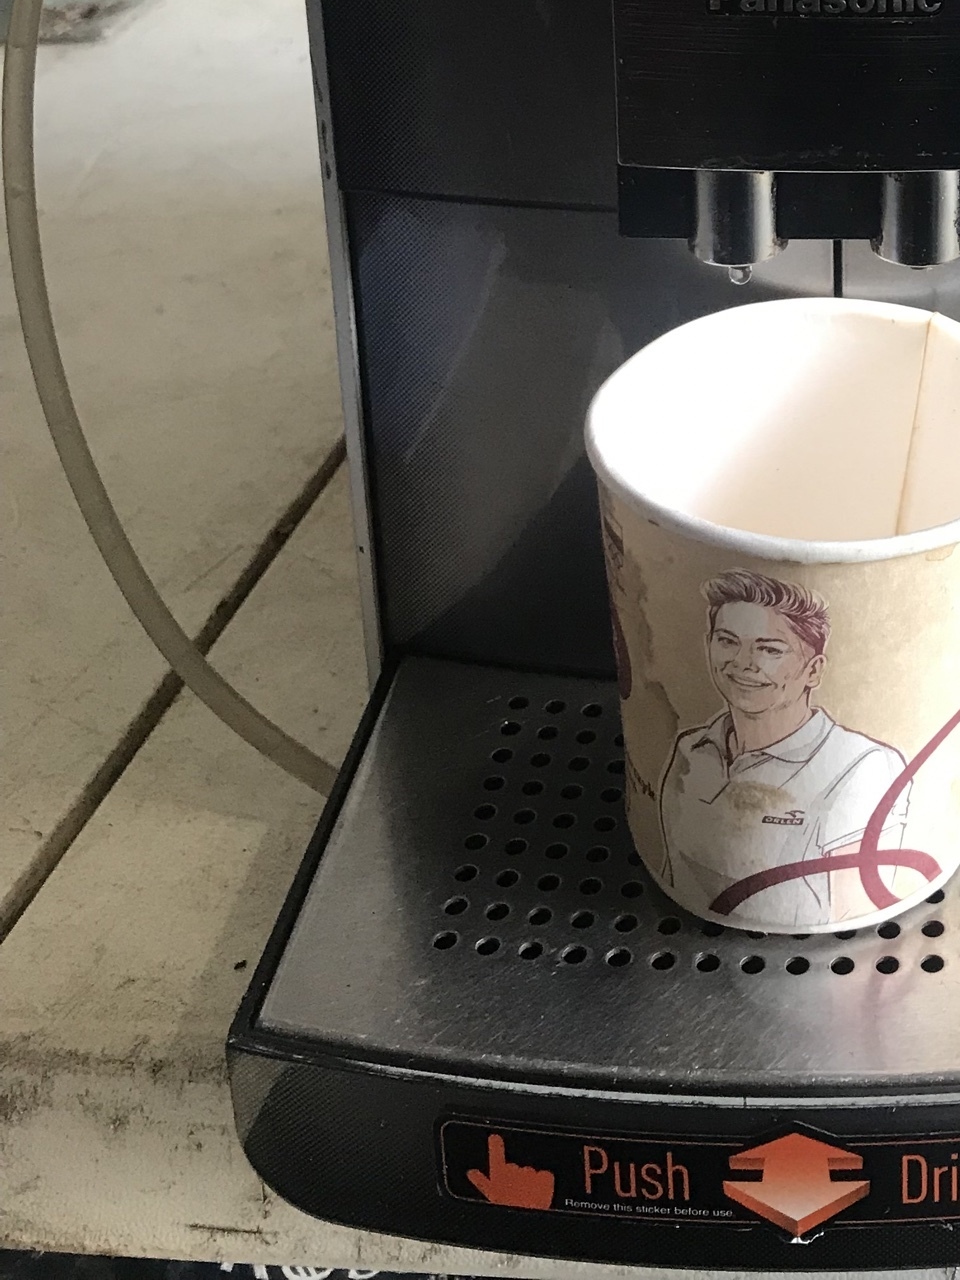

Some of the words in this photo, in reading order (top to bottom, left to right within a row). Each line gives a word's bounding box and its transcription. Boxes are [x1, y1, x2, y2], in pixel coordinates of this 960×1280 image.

[764, 816, 802, 824] ORLEN
[583, 1145, 690, 1200] Push
[565, 1198, 610, 1211] Remove
[613, 1203, 633, 1212] this
[635, 1205, 671, 1215] sticker
[674, 1206, 710, 1217] before
